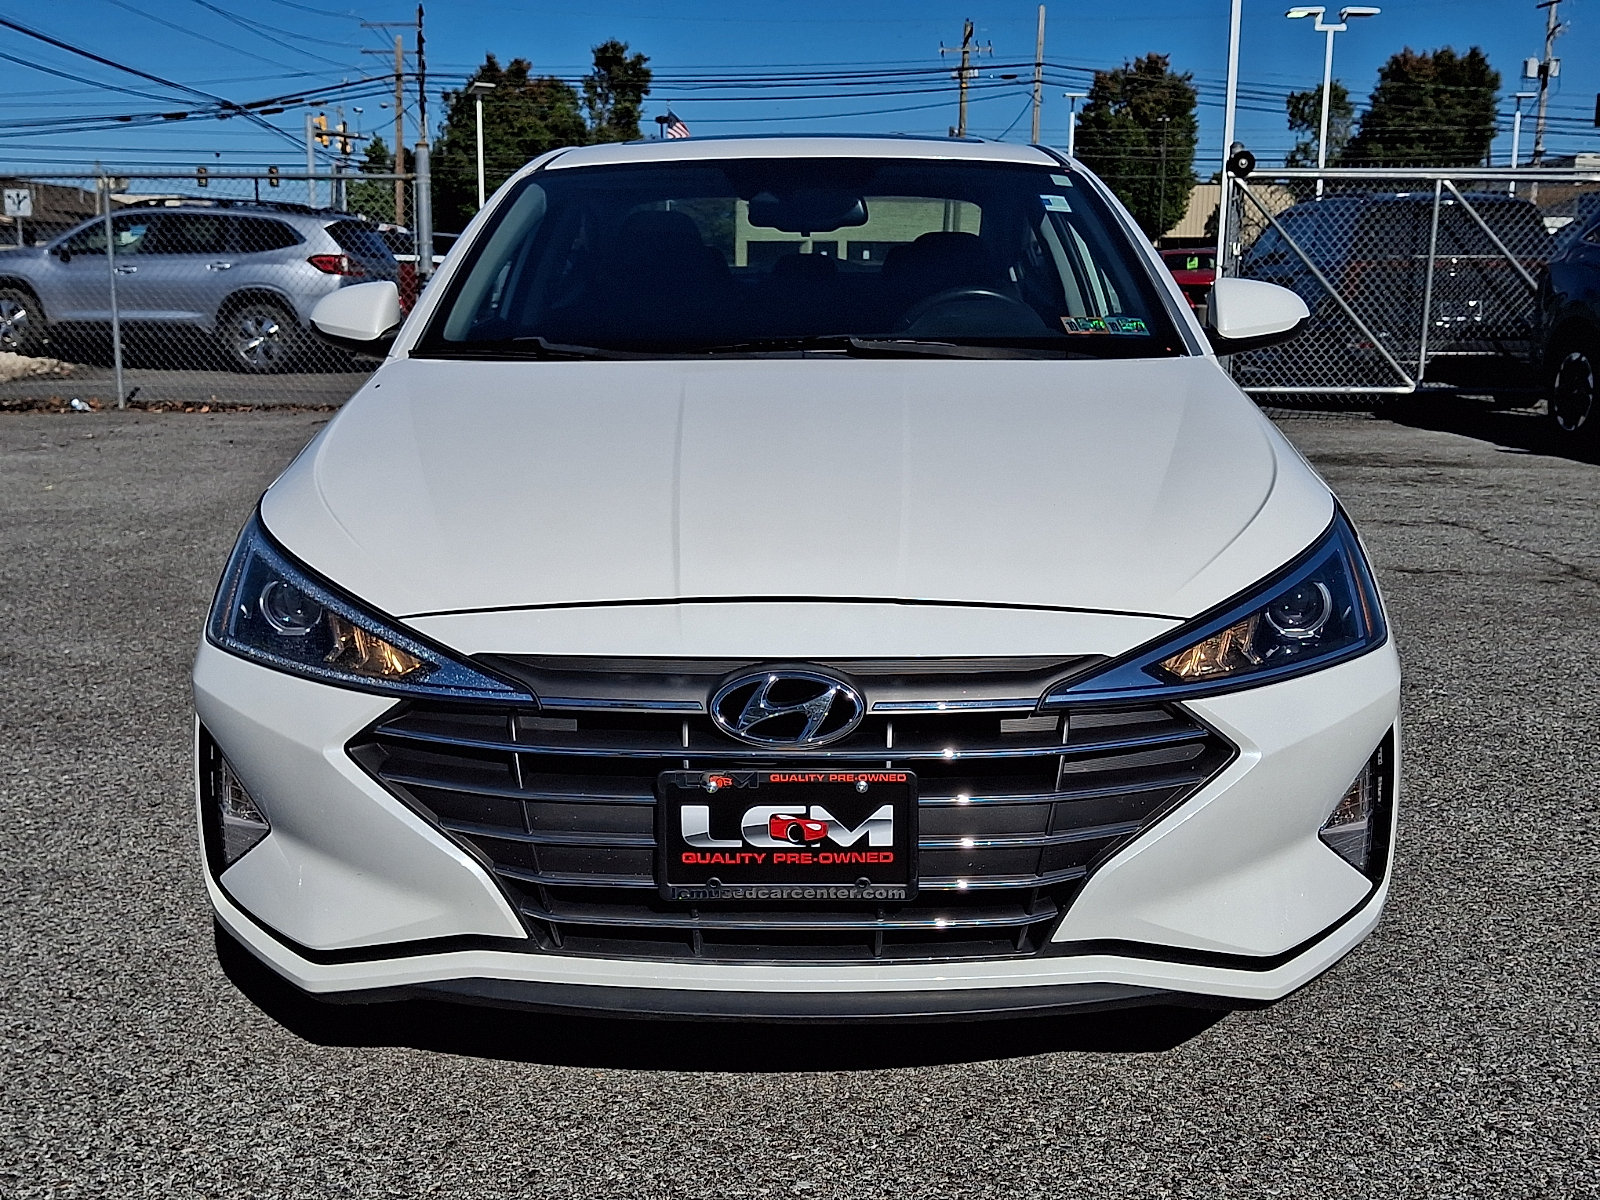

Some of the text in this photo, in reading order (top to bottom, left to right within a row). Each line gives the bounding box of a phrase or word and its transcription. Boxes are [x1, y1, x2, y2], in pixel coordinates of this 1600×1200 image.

[769, 774, 825, 782] QUALITY
[829, 773, 907, 782] PRE-OWNED
[681, 804, 893, 848] LCM
[681, 852, 894, 864] QUALITY PRE-OWNED
